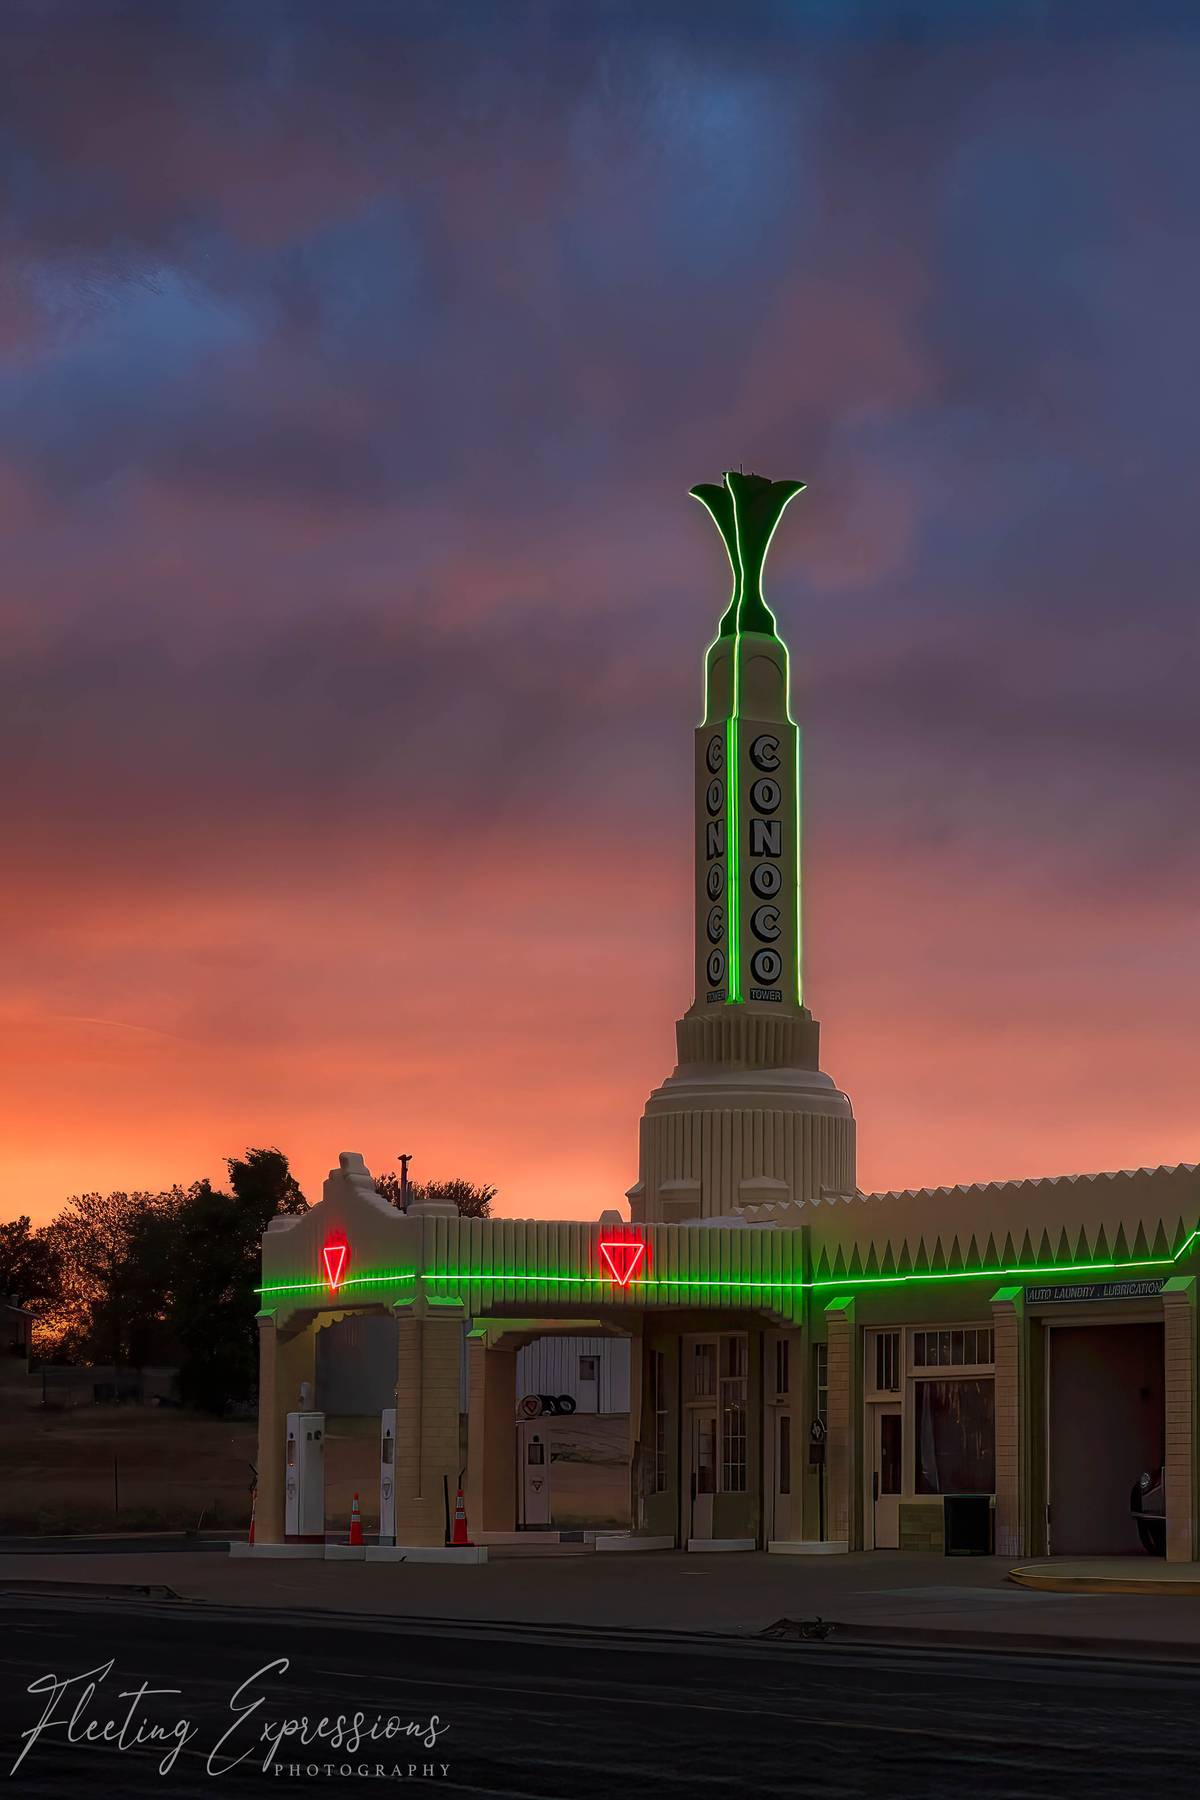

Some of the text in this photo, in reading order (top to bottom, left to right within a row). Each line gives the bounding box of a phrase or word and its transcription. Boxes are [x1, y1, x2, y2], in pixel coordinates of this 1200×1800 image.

[706, 735, 725, 986] CONOCO
[750, 734, 782, 986] CONOCO
[751, 989, 781, 1001] TOWER
[1029, 1288, 1051, 1301] AUTO
[1054, 1286, 1095, 1300] LAUNDRY
